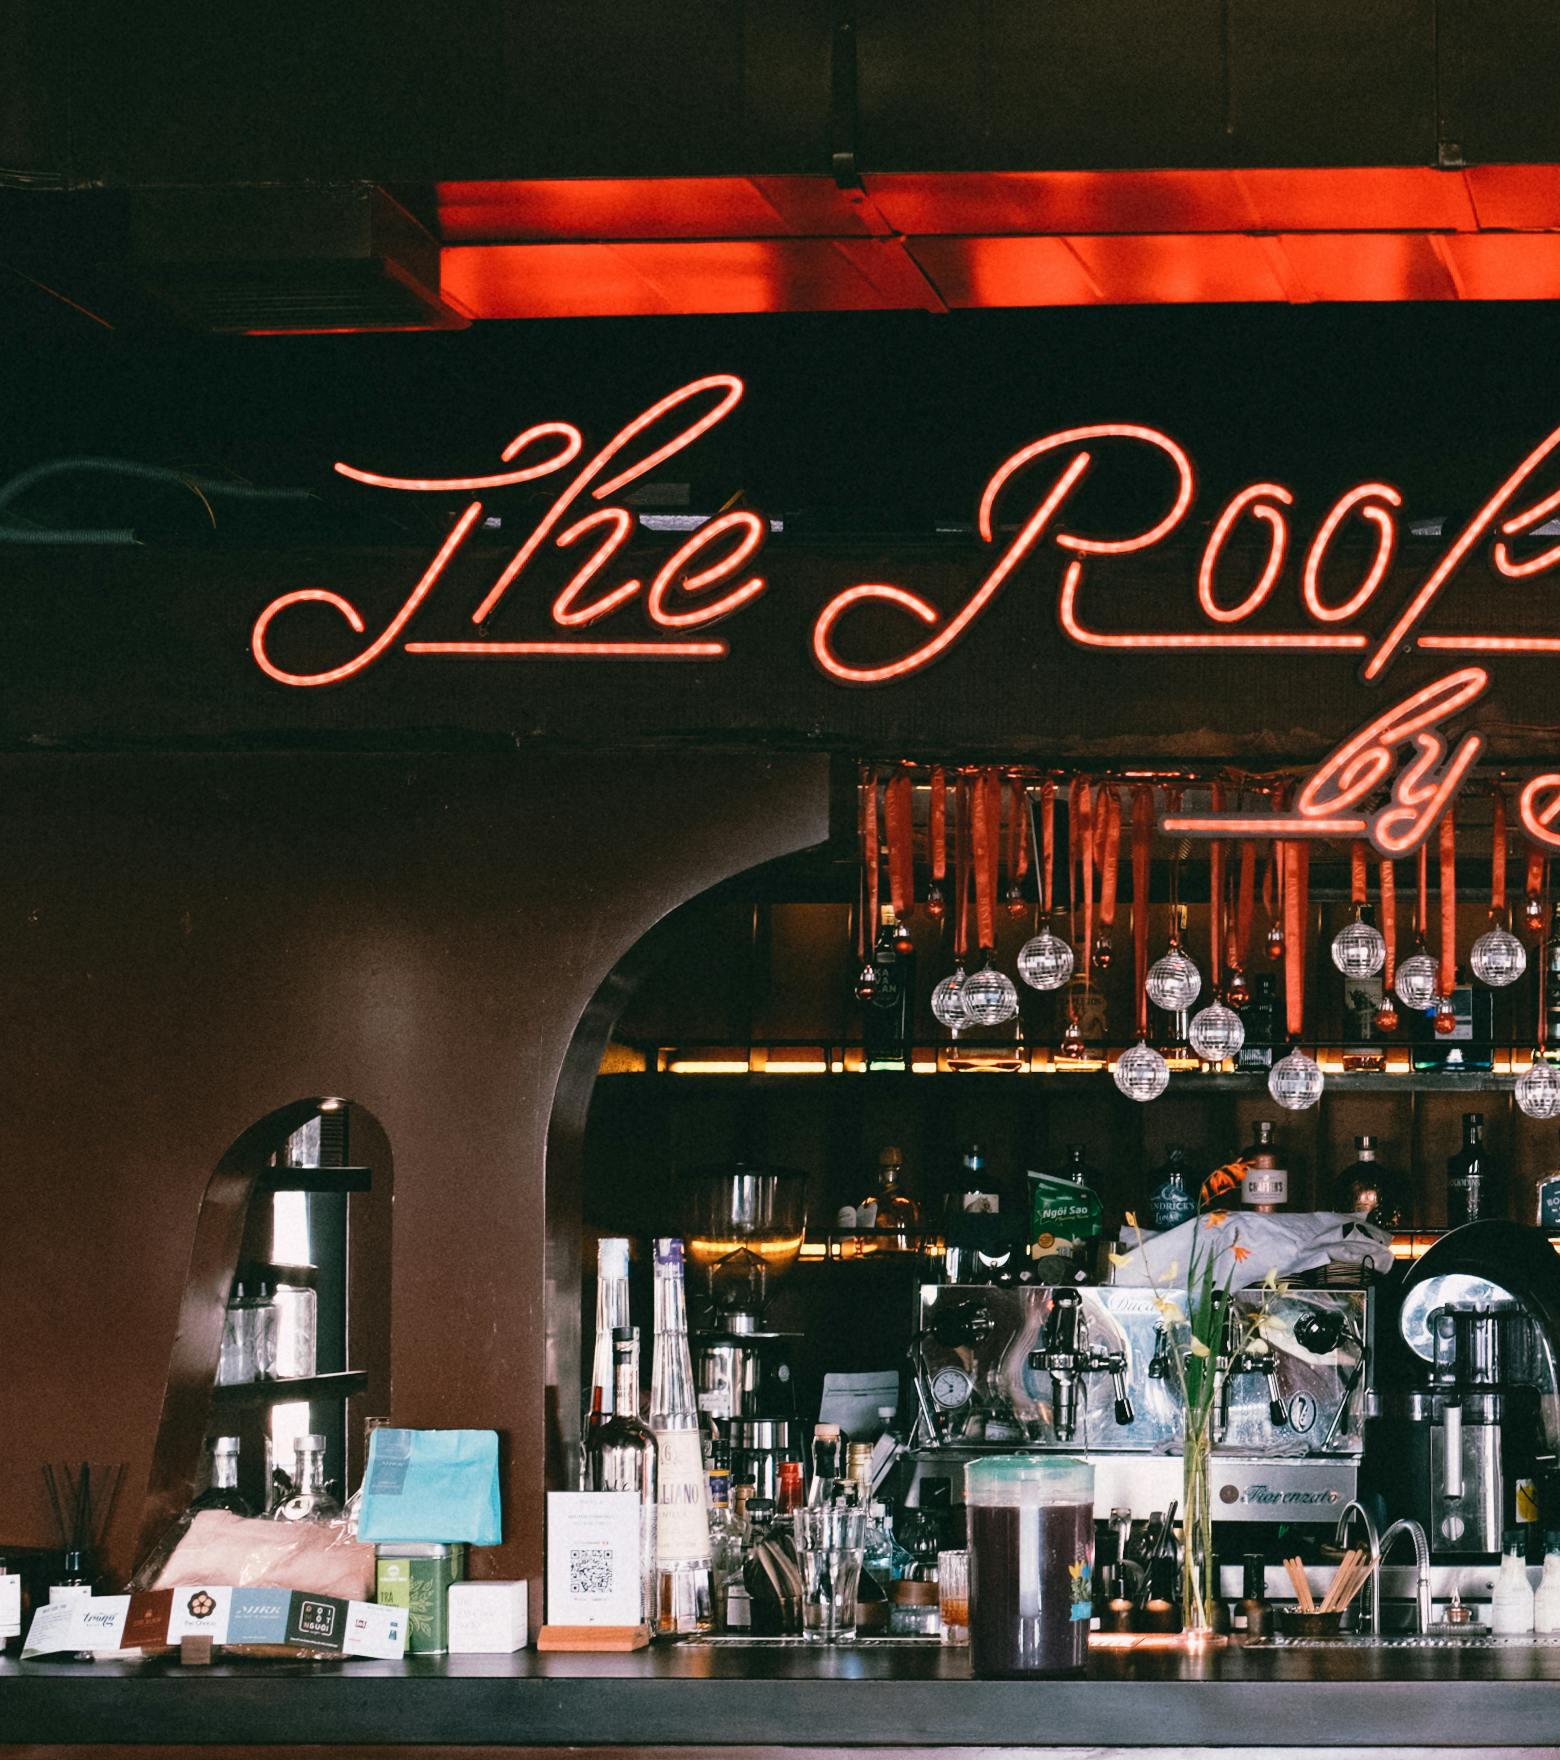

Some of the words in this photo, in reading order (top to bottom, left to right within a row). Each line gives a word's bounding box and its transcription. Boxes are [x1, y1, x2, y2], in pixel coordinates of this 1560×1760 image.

[251, 373, 767, 688] The
[1299, 668, 1488, 853] by
[1382, 860, 1393, 897] BANLA
[1043, 1206, 1068, 1219] Ngôi
[1069, 1205, 1088, 1215] Sao
[1153, 1201, 1195, 1211] NDRICK'S
